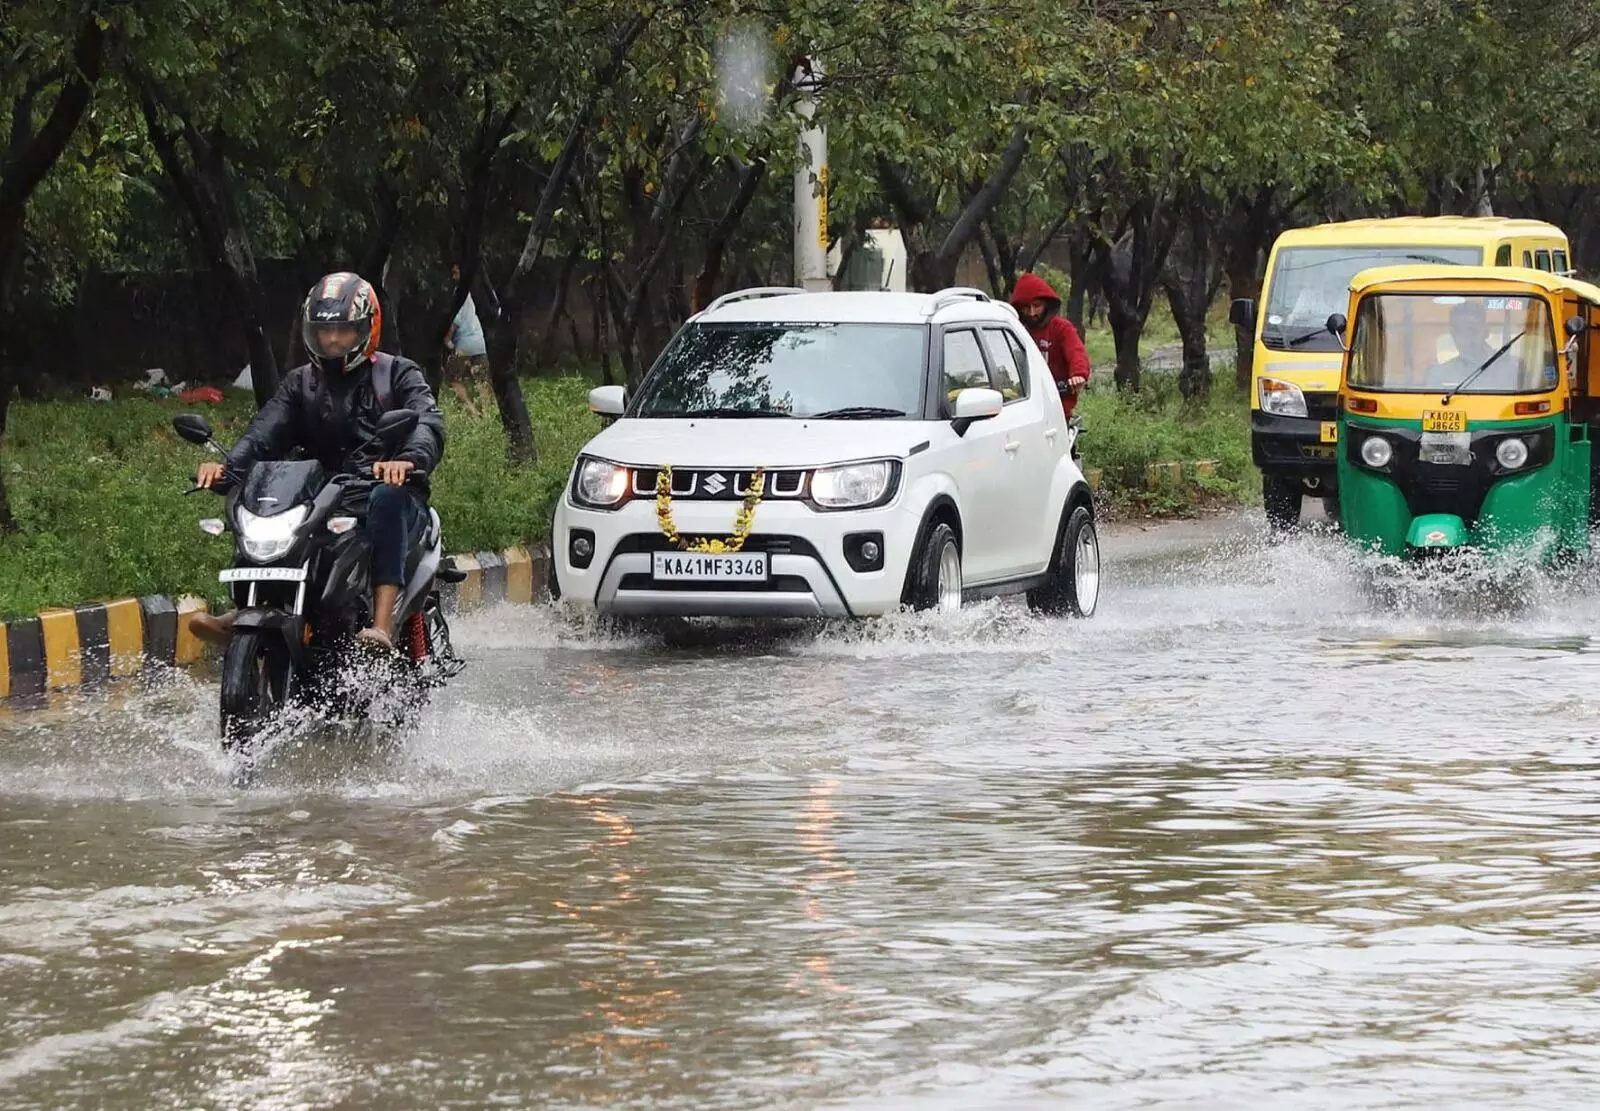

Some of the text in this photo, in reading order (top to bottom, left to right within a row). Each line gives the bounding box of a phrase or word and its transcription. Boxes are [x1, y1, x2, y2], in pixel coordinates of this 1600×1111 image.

[1430, 411, 1460, 421] KA02A
[1431, 421, 1460, 430] J8645
[664, 558, 763, 575] KA41MF3348
